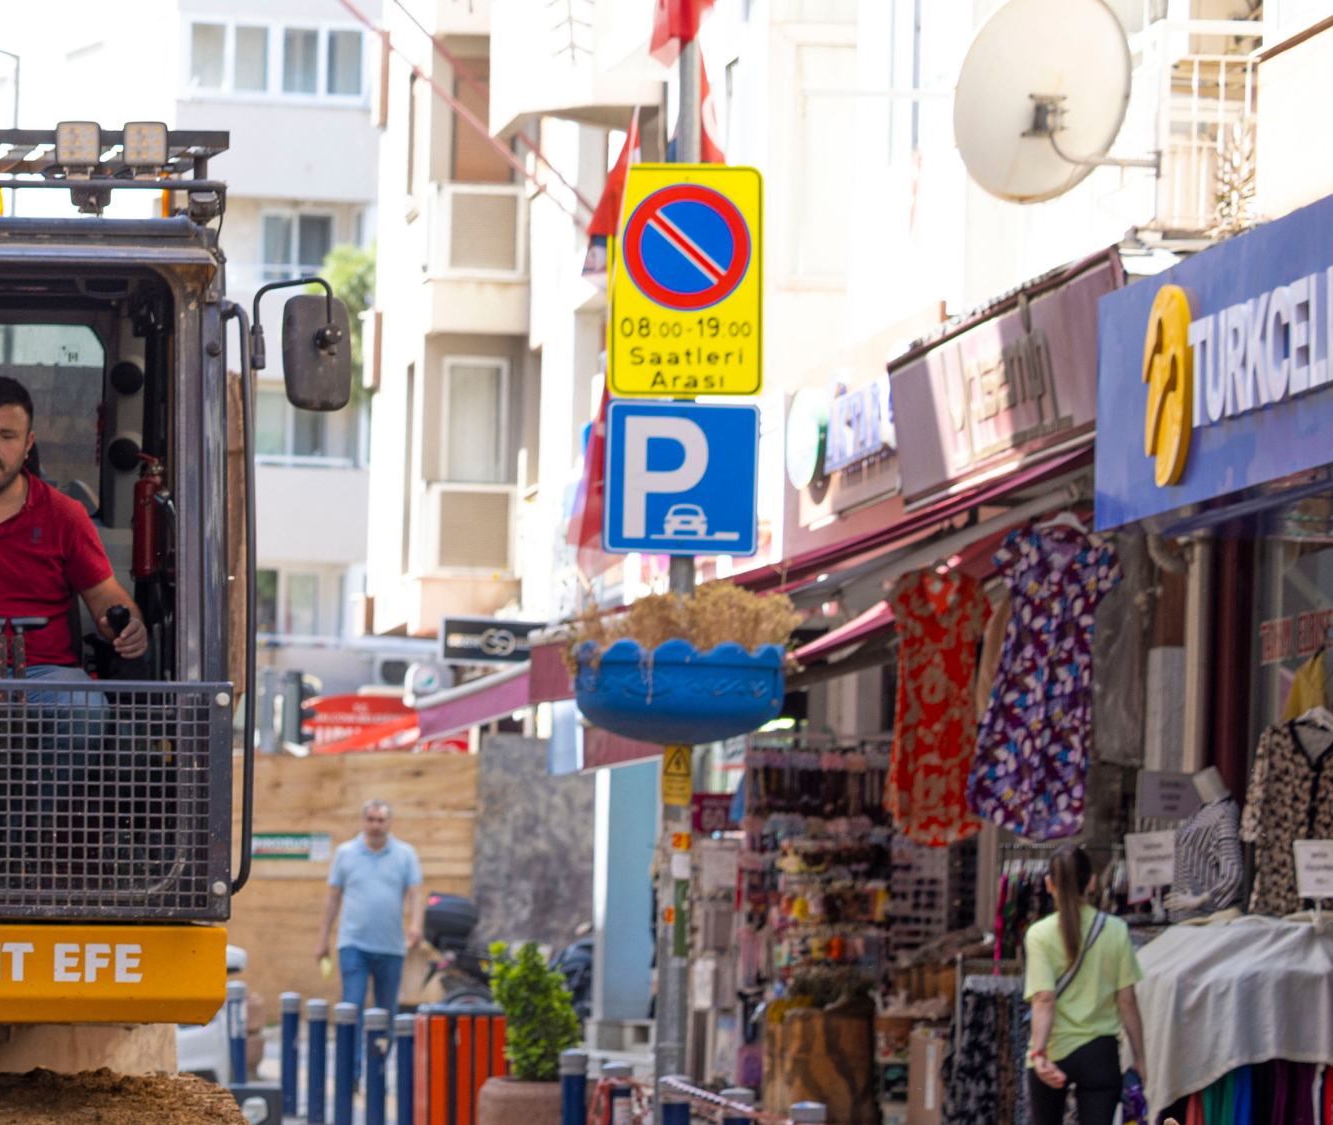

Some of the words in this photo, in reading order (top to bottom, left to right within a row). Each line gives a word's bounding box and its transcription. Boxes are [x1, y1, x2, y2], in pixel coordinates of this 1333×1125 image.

[630, 347, 744, 366] Saatleri
[650, 371, 725, 389] Arası
[53, 942, 143, 984] EFE
